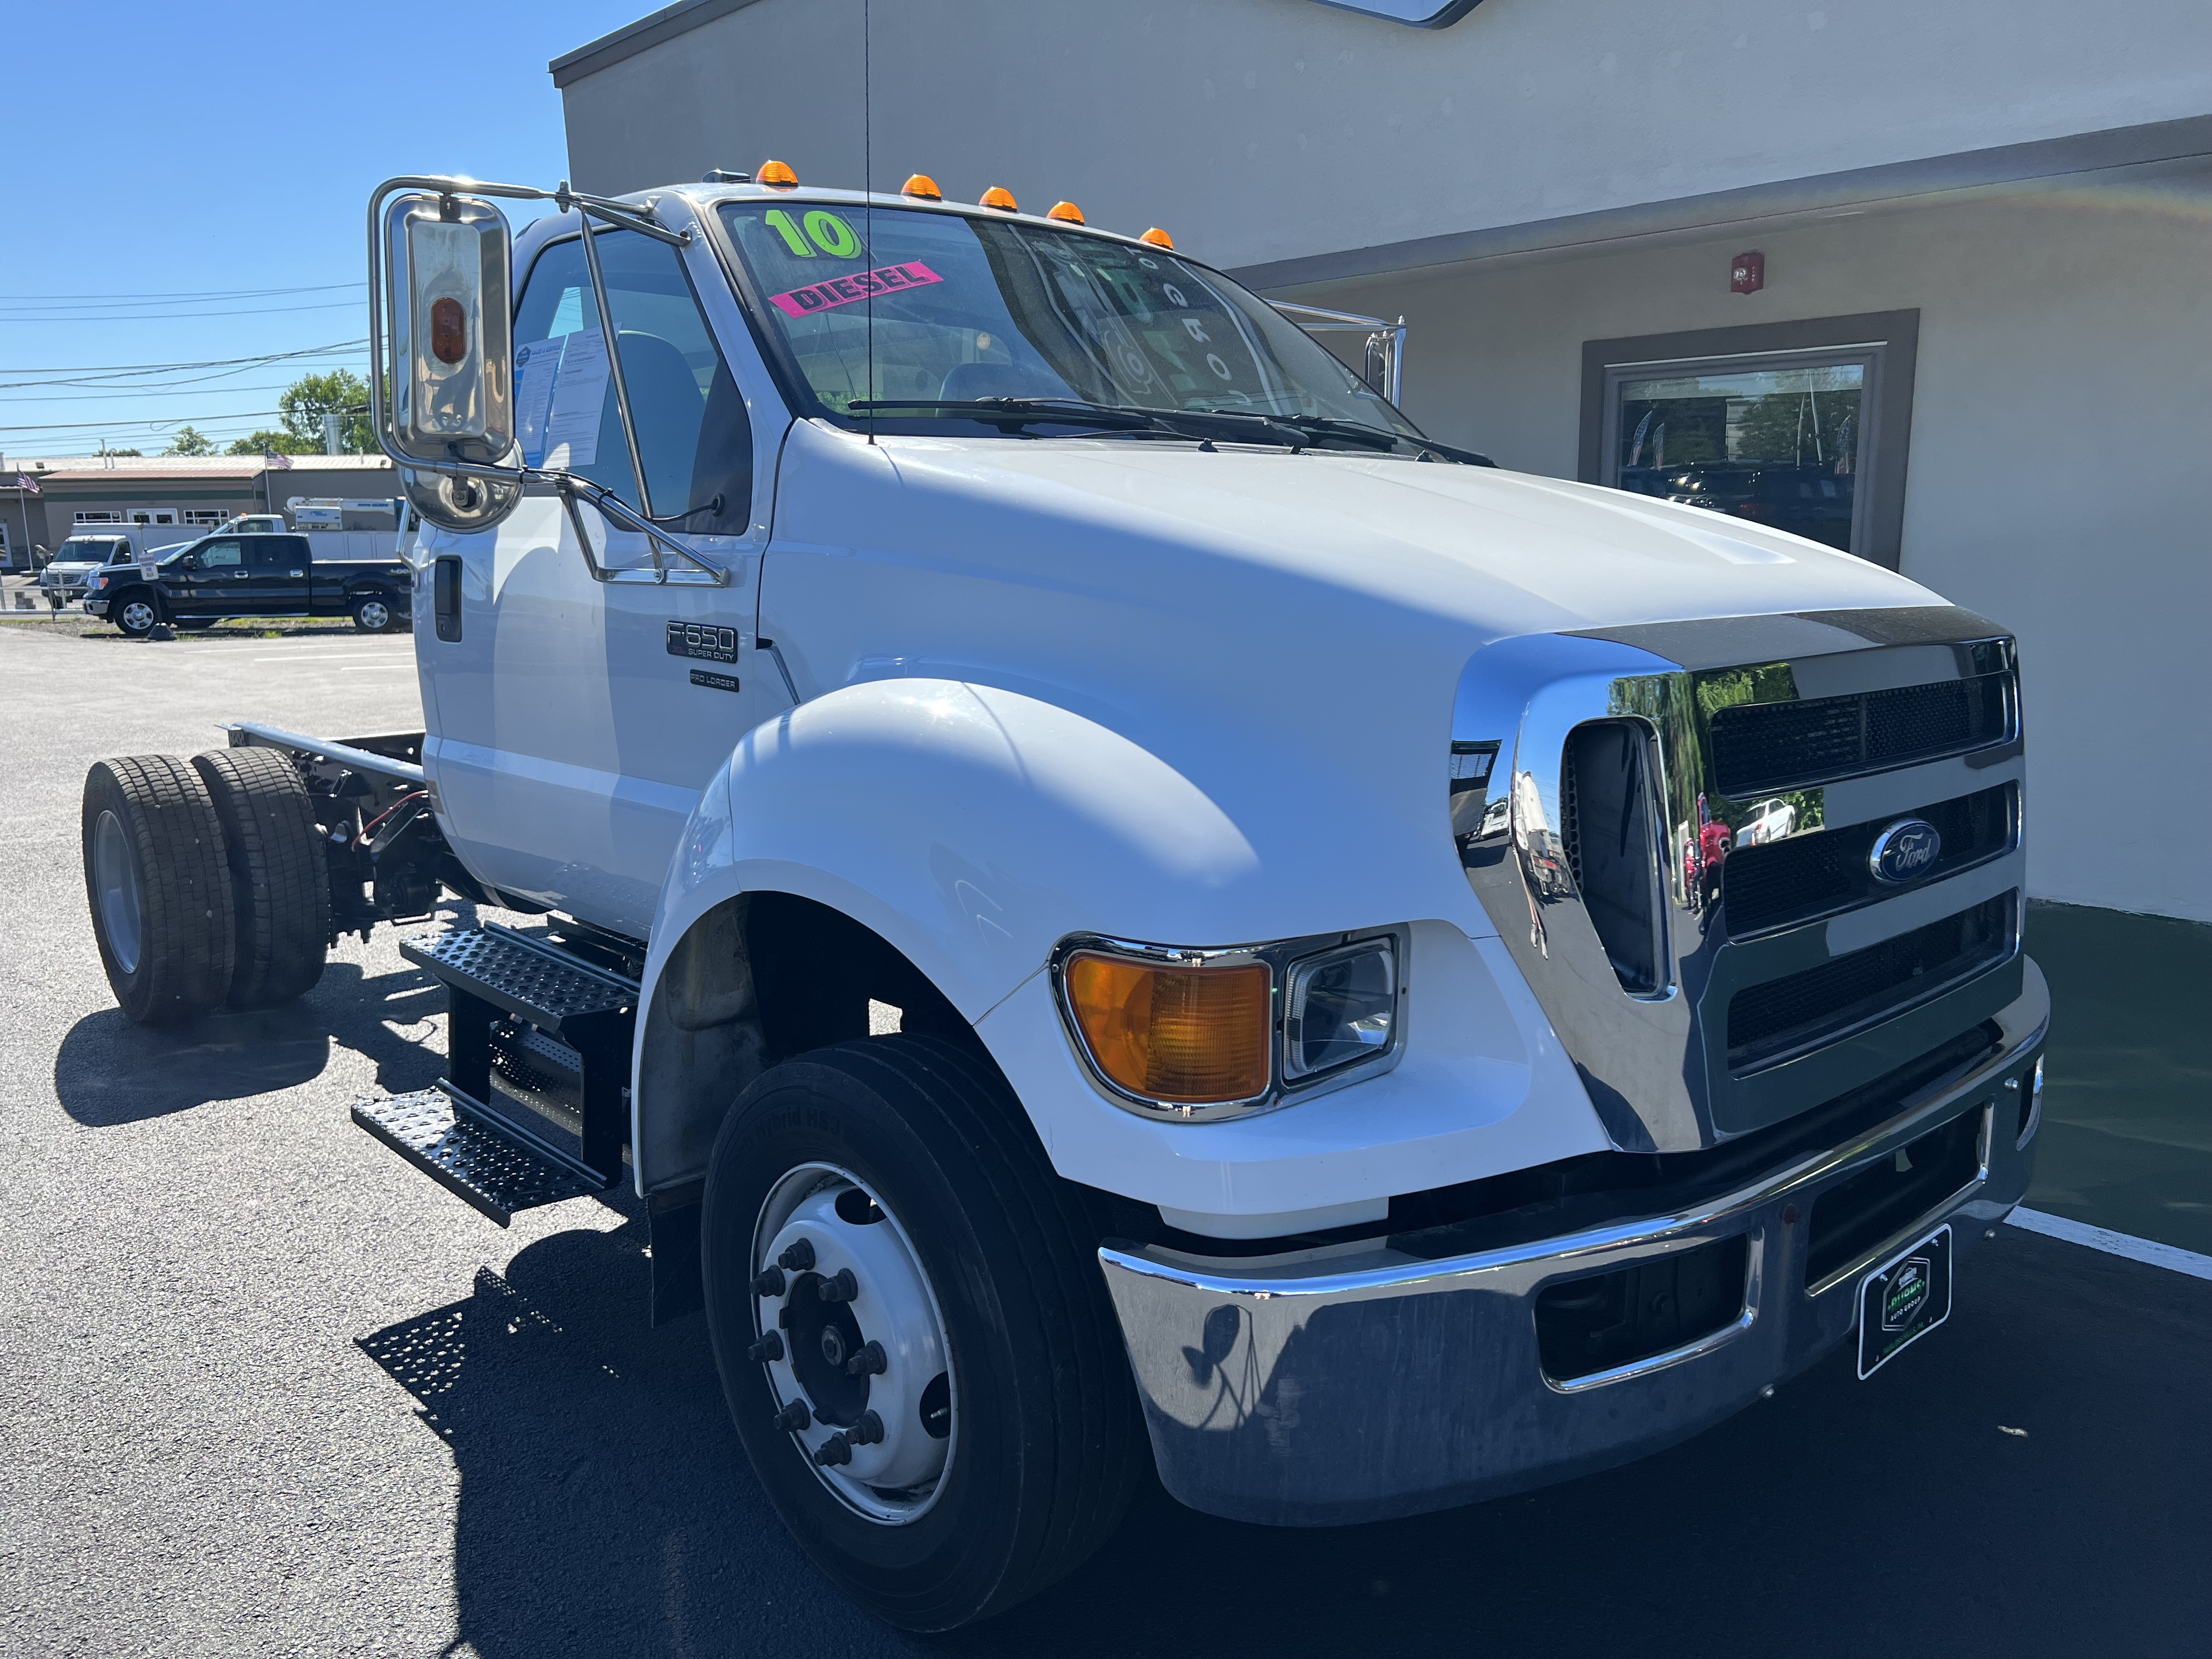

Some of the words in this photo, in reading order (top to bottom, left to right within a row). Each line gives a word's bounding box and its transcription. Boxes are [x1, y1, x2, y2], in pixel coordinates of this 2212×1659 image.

[765, 210, 862, 259] 10
[789, 266, 932, 312] DIESEL
[688, 648, 712, 658] SUPER
[714, 652, 734, 661] DUTY
[690, 673, 705, 682] PRO
[706, 676, 736, 688] LOADER
[1895, 832, 1932, 872] Ford
